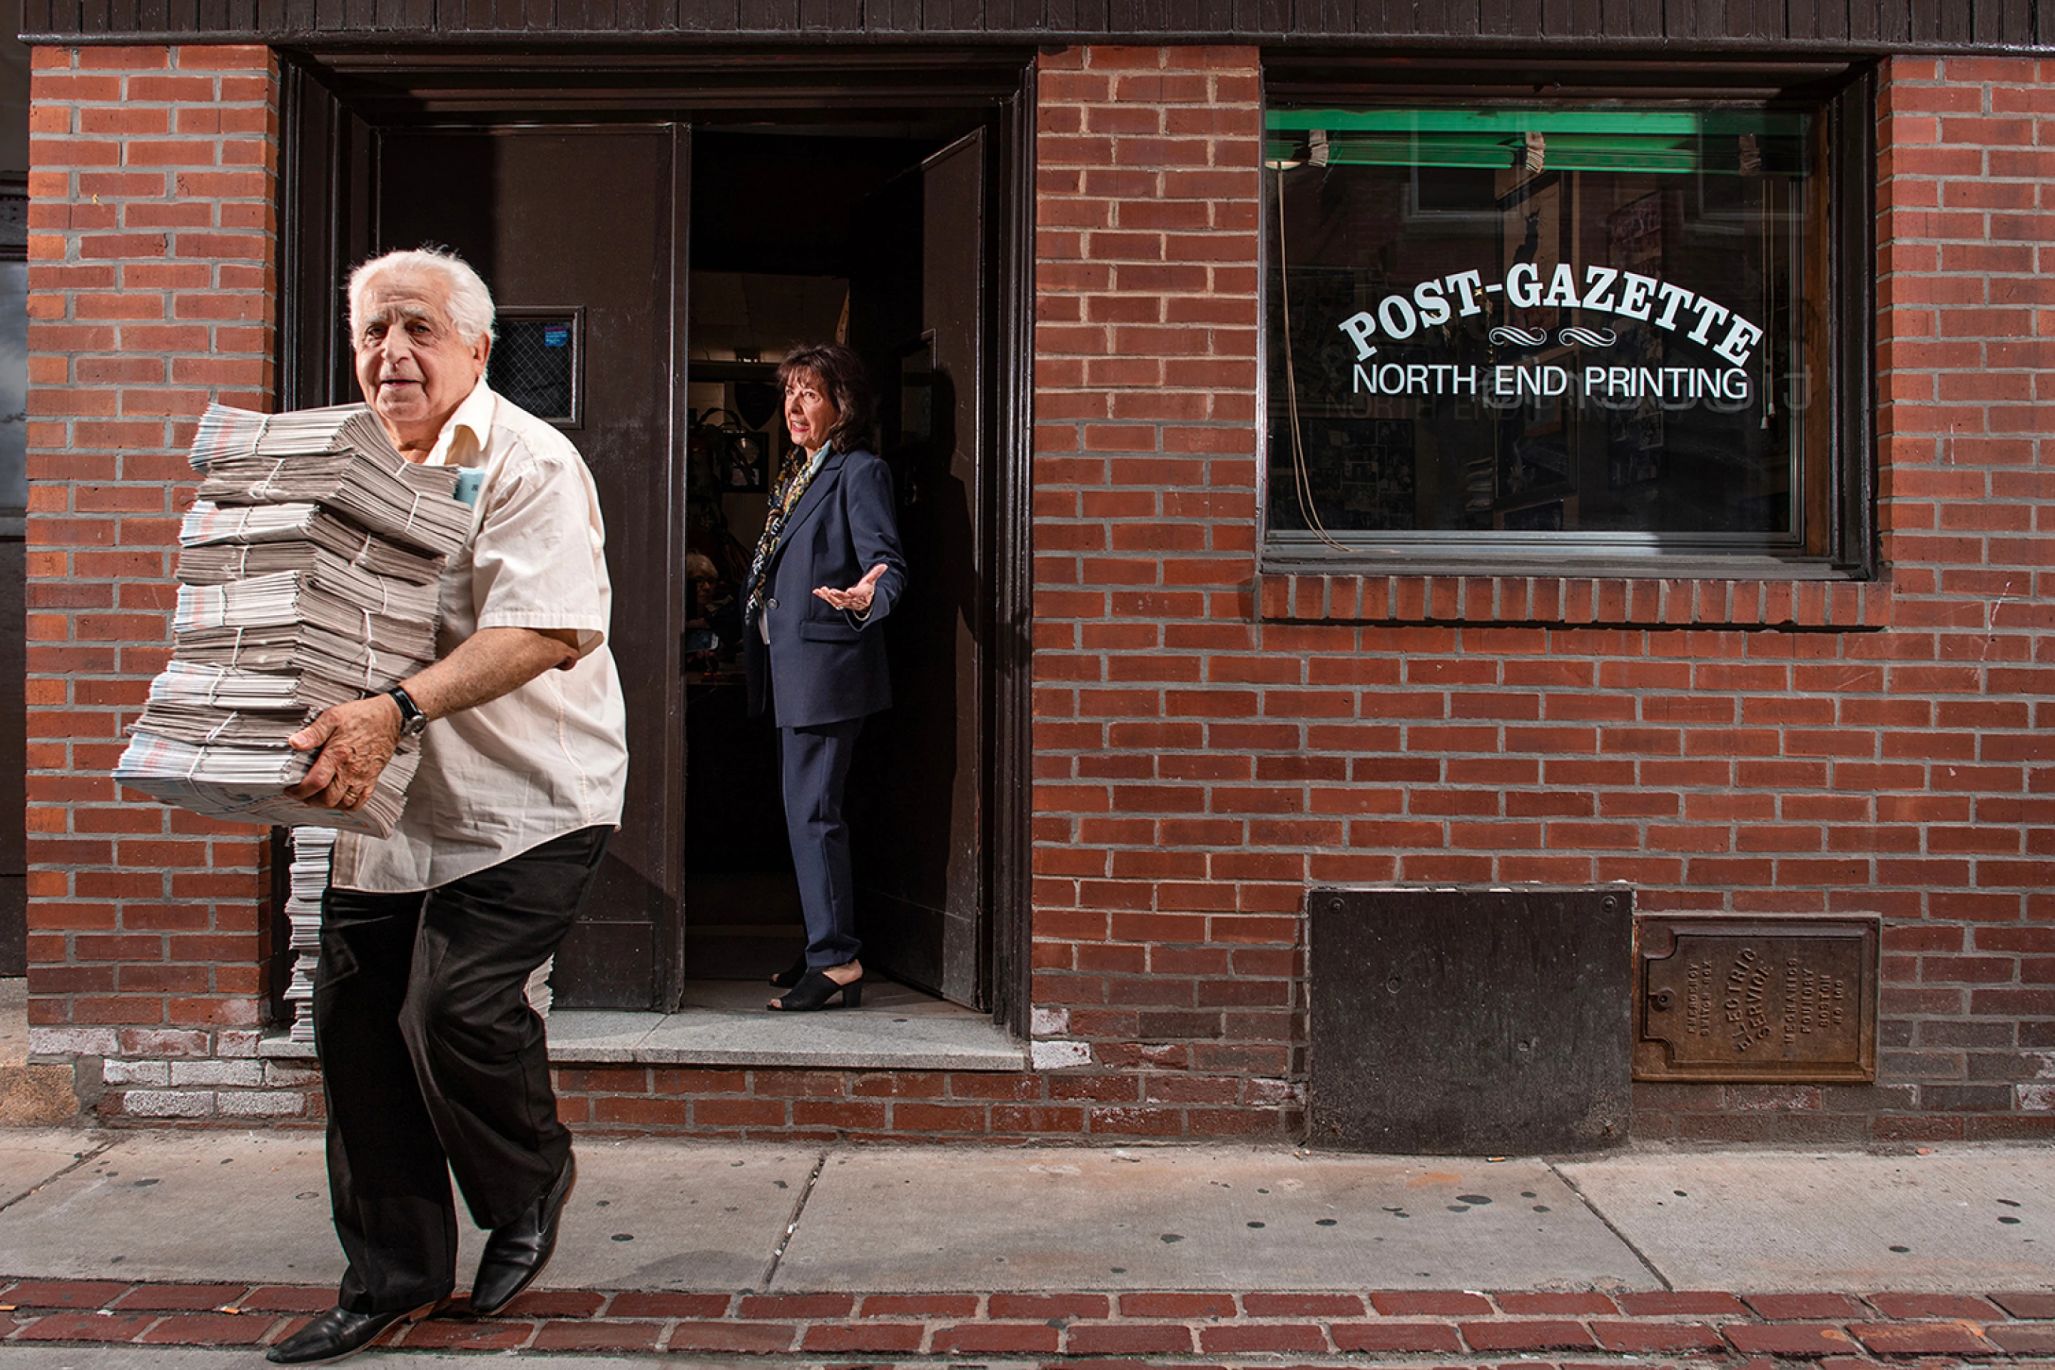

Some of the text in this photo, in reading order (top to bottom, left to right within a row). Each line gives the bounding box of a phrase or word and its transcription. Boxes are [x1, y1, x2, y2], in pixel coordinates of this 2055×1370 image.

[1337, 261, 1765, 369] POST-GAZETTE
[1352, 362, 1477, 395] NORTH
[1494, 364, 1569, 397] END
[1584, 365, 1749, 400] PRINTING
[1723, 946, 1757, 1052] ELECTRIC
[1745, 958, 1774, 1040] SERVICE
[1799, 967, 1814, 1035] FOUNDRY
[1817, 973, 1832, 1029] BOSTON
